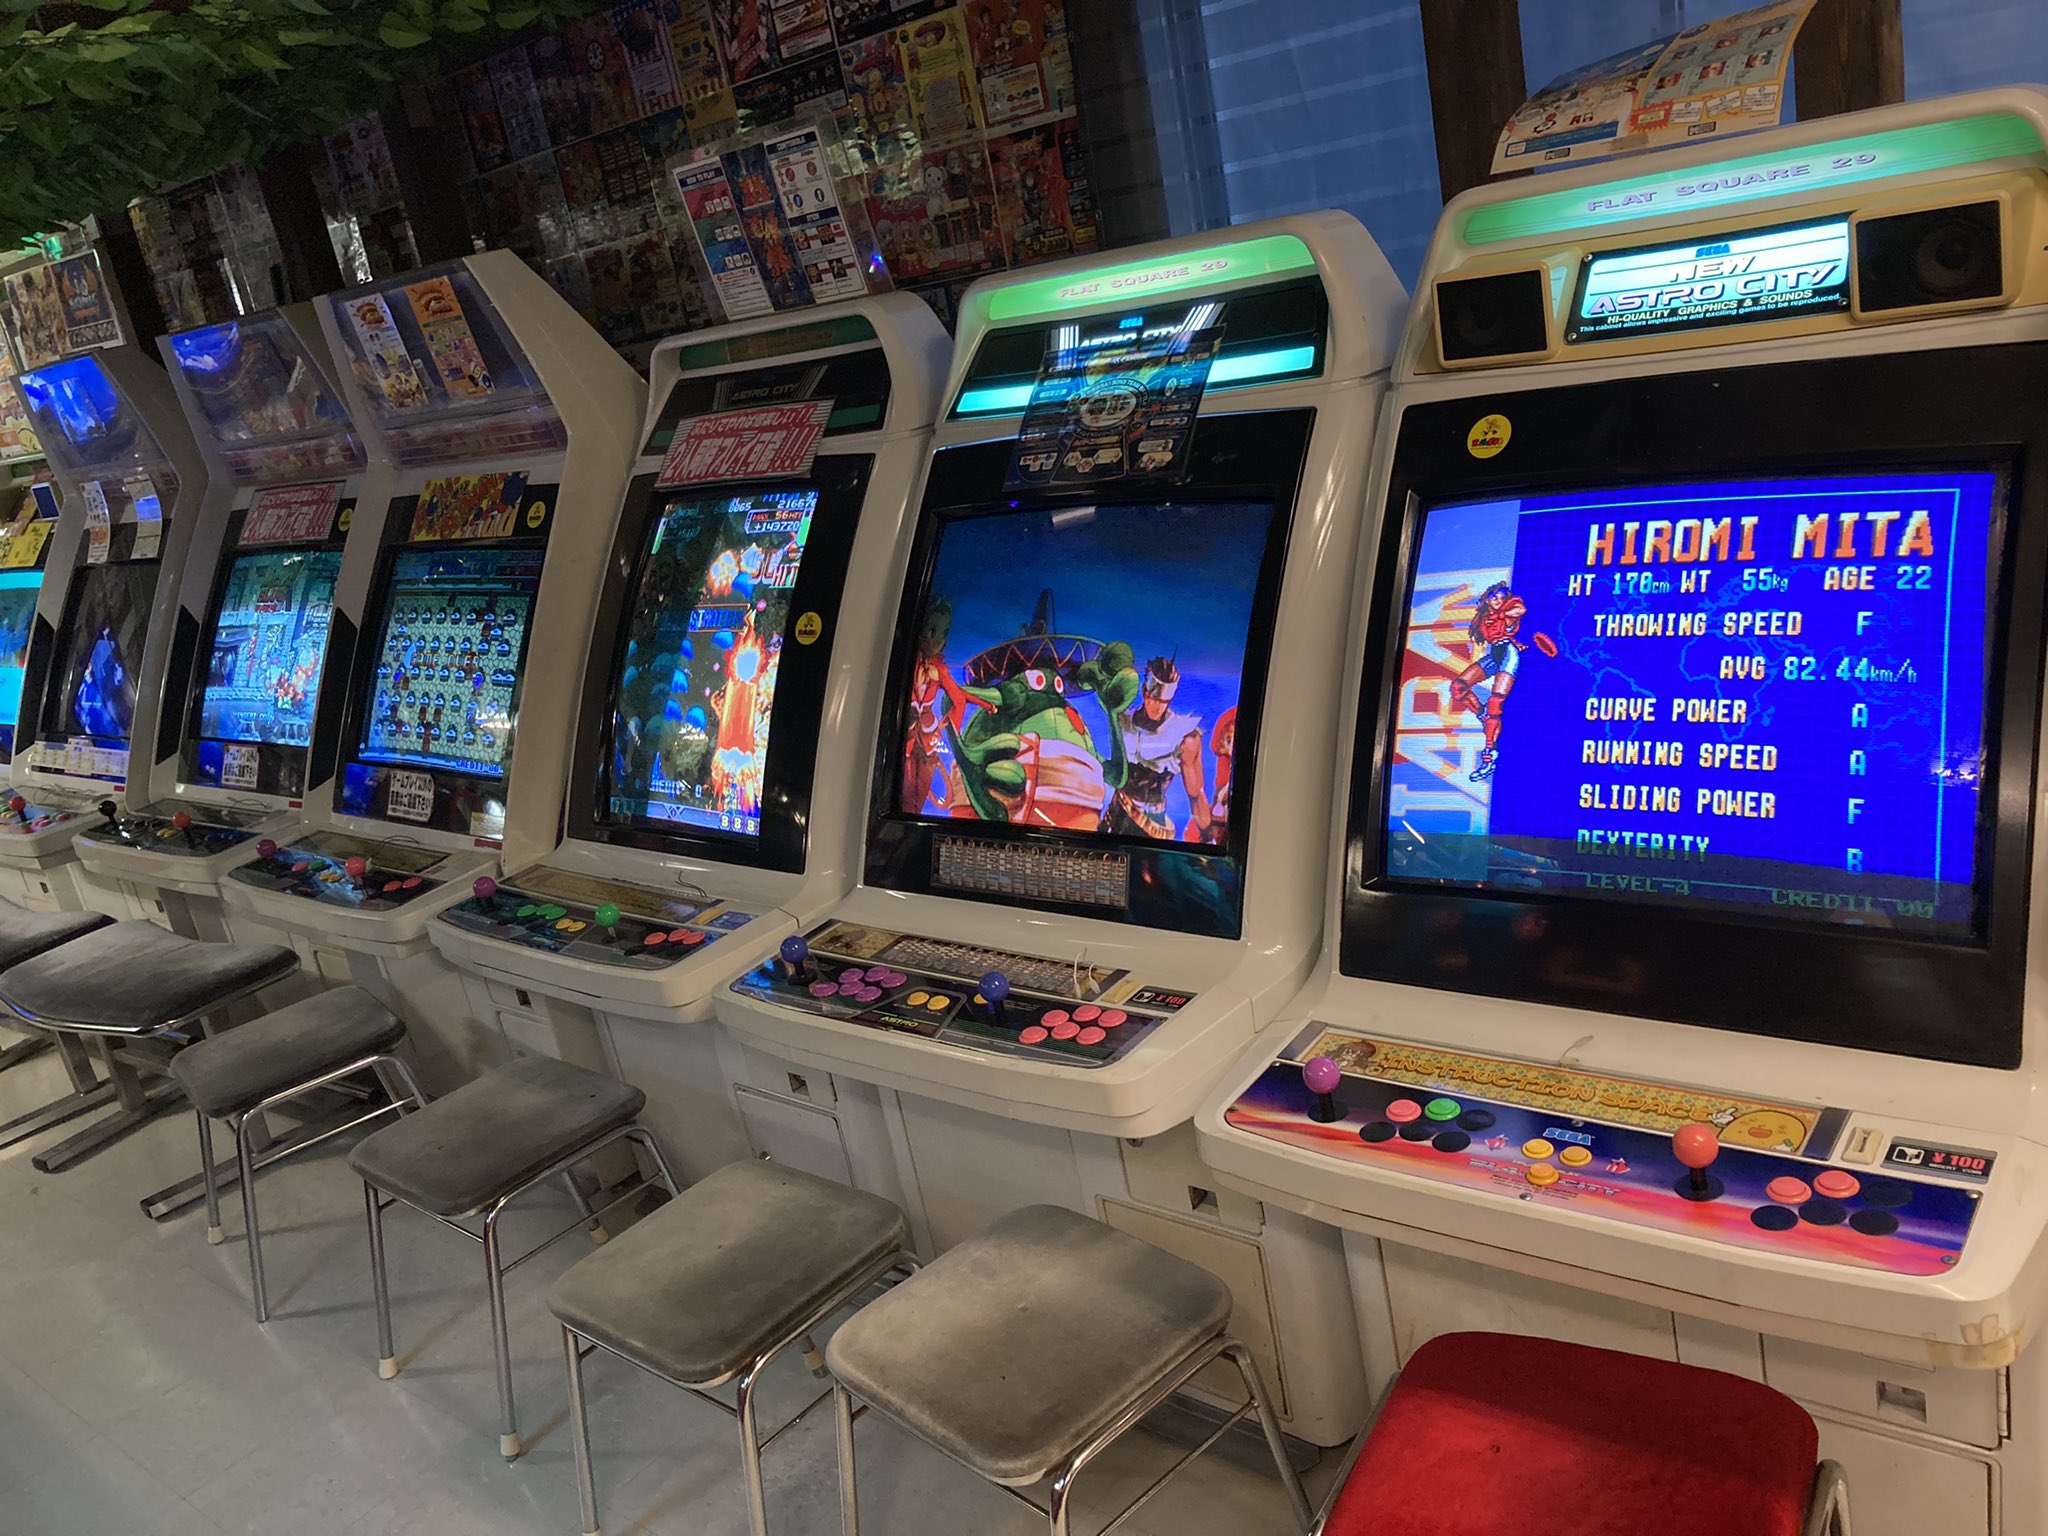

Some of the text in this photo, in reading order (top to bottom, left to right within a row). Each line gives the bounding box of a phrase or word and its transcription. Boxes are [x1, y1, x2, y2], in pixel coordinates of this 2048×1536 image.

[1588, 153, 1876, 212] FLAT SQUARE 29
[1695, 244, 1731, 258] SEGA
[1059, 260, 1228, 298] FLAT SQUARE 29
[1669, 256, 1756, 283] NEW
[1588, 262, 1840, 316] ASTRO CITY
[1595, 321, 1622, 332] cabinet
[1623, 319, 1647, 328] allows
[1647, 313, 1687, 327] impressive
[1689, 311, 1704, 320] and
[1706, 308, 1737, 320] exciting
[1738, 304, 1766, 316] games
[1777, 299, 1789, 309] be
[1607, 289, 1813, 325] HI-QUALITY GRAPHICS & SOUNDS
[1586, 510, 1934, 567] HIROMI MITA
[1568, 574, 1597, 597] HT
[1680, 569, 1712, 594] WT
[1742, 567, 1789, 592] 55kg
[1823, 566, 1877, 591] AGE
[1896, 565, 1933, 590] 22
[1593, 611, 1874, 637] THROWING SPEED F
[1719, 655, 1766, 680] AVG
[1391, 567, 1513, 836] JAPAN
[1585, 697, 1869, 728] CURVE POWER A
[1582, 740, 1866, 776] RUNNING SPEED A
[1579, 784, 1865, 825] SLIDING POWER F
[1576, 829, 1863, 875] DEXTERITY B
[1771, 889, 1873, 913] CREDIT
[880, 1016, 919, 1028] ASTRO
[1385, 1053, 1597, 1102] INSTRUCTION
[1543, 1127, 1592, 1146] SEGA
